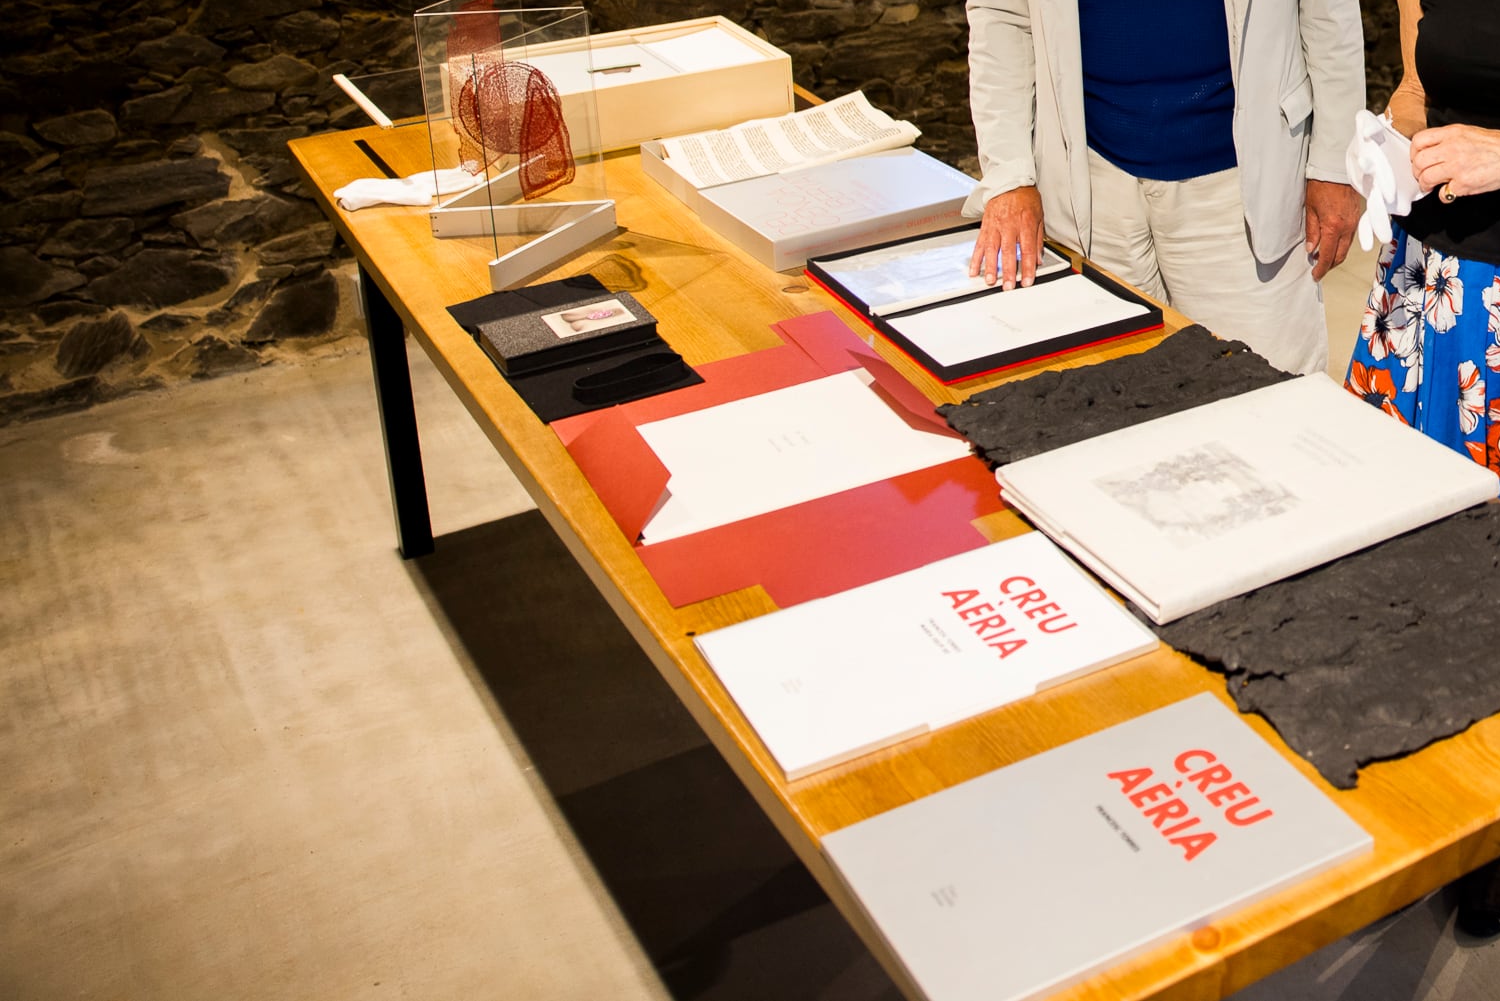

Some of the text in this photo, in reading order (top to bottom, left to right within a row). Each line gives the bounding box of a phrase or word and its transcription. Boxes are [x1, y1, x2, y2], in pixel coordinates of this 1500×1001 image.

[941, 589, 1028, 660] AÈRIA
[1000, 575, 1078, 634] CREU
[1106, 767, 1219, 862] AÈRIA
[1174, 749, 1275, 828] CREU
